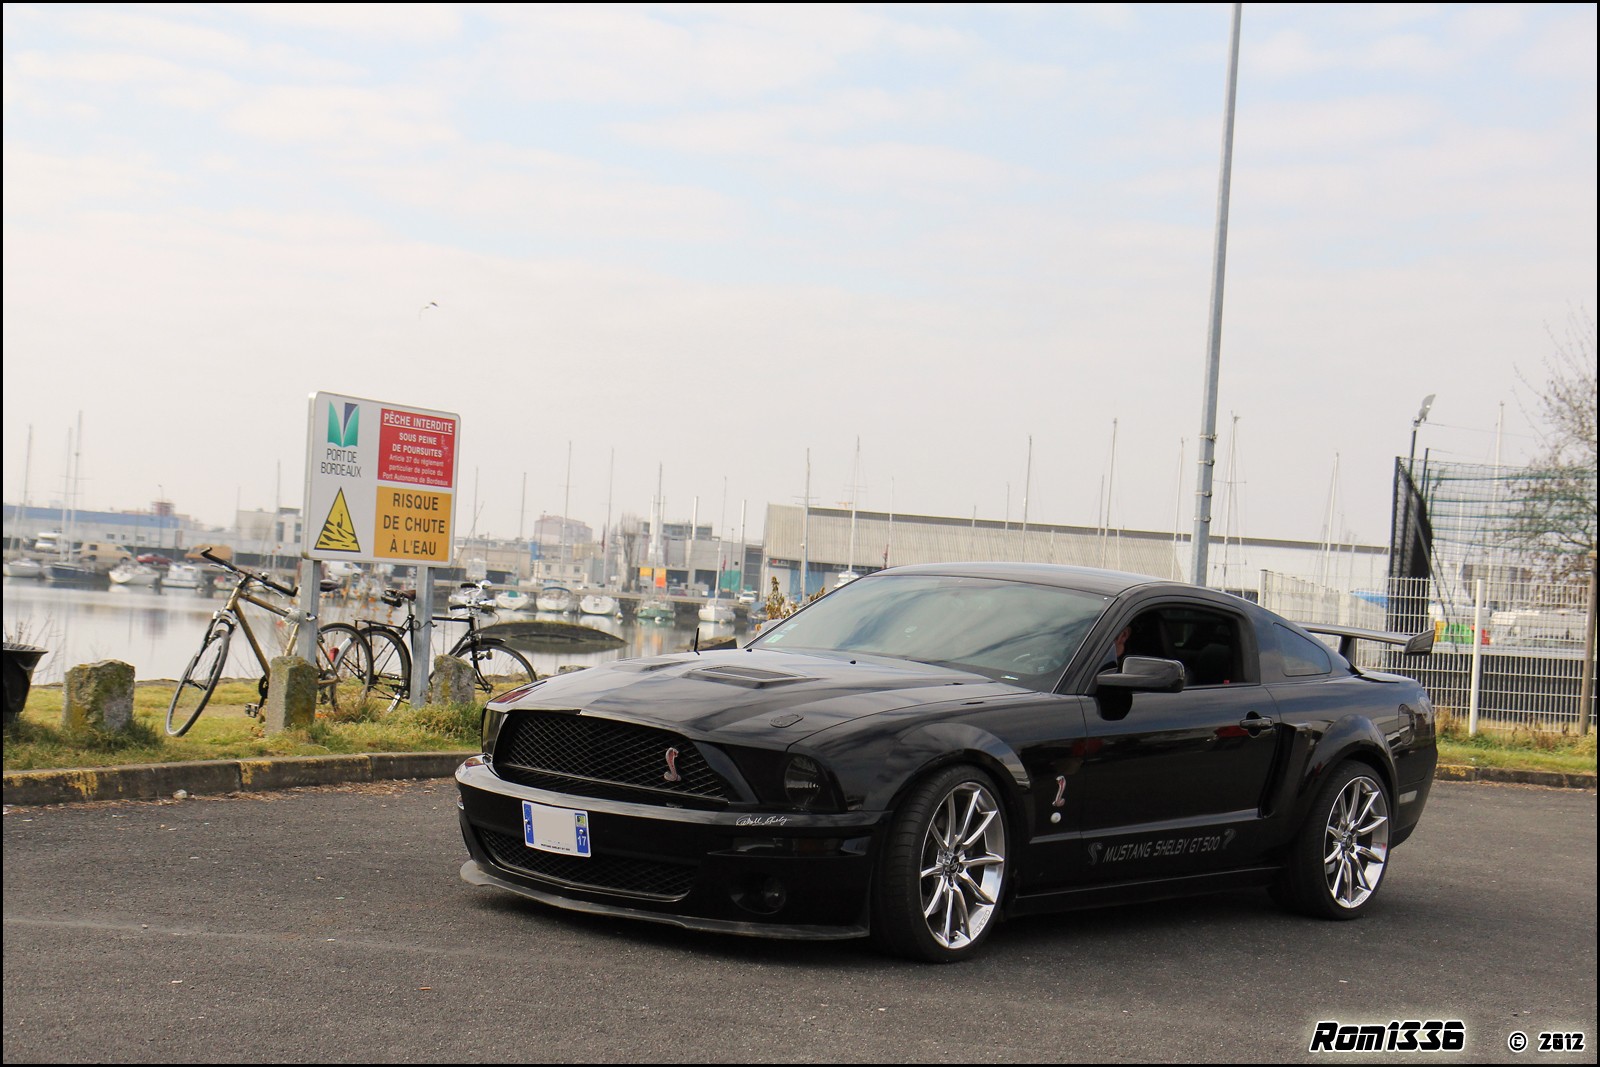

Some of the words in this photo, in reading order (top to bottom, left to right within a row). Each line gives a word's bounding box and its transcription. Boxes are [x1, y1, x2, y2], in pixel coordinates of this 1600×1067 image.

[384, 411, 410, 426] PÊCHE
[414, 418, 452, 432] INTERDITE
[399, 432, 417, 443] SOUS
[418, 435, 437, 445] PEINE
[326, 448, 346, 462] PORT
[348, 452, 356, 463] DE
[392, 444, 402, 452] DE
[403, 446, 442, 458] POURSUITES
[320, 462, 362, 478] BORDEAUX
[394, 474, 418, 482] Autonome
[426, 477, 448, 486] Bordeaux
[393, 493, 439, 510] RISQUE
[384, 515, 400, 530] DE
[405, 517, 445, 534] CHUTE
[390, 534, 398, 553] À
[404, 540, 436, 556] L'EAU
[527, 824, 531, 833] F
[578, 836, 586, 846] 17
[1102, 842, 1152, 863] MUSTANG
[1153, 838, 1190, 856] SHELBY
